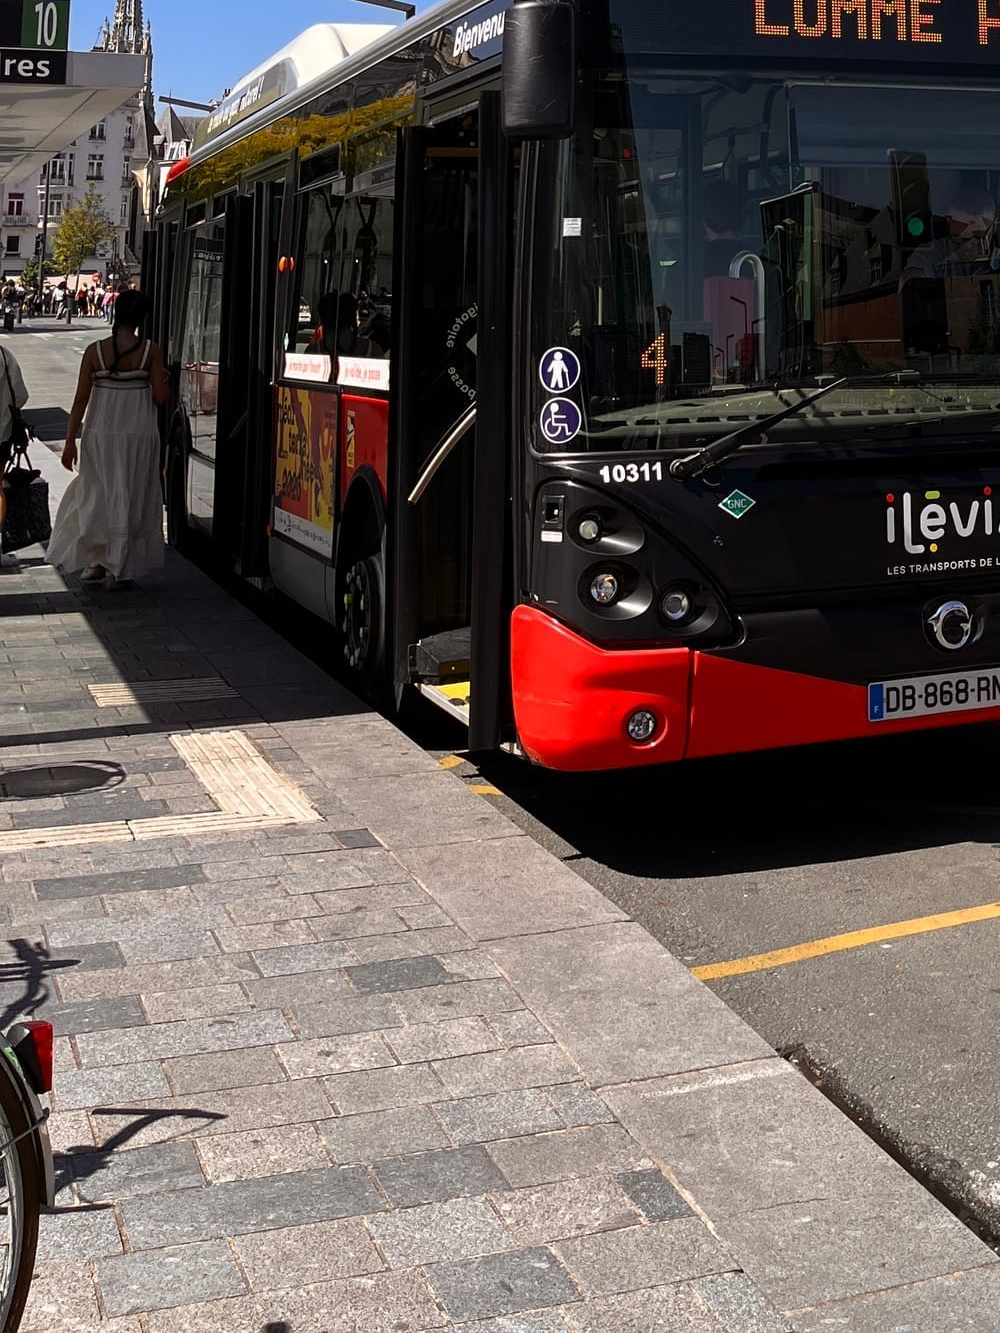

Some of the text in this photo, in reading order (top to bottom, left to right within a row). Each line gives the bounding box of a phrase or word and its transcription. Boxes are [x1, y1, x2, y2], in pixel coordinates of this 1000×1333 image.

[35, 1, 58, 46] 10
[452, 10, 506, 58] Bienvenu
[0, 54, 50, 77] res
[641, 333, 667, 384] 4
[600, 462, 663, 484] 10311
[727, 498, 747, 510] GNC
[887, 566, 906, 576] LES
[909, 559, 977, 574] TRANSPORTS
[979, 557, 993, 568] DE
[873, 705, 880, 715] F
